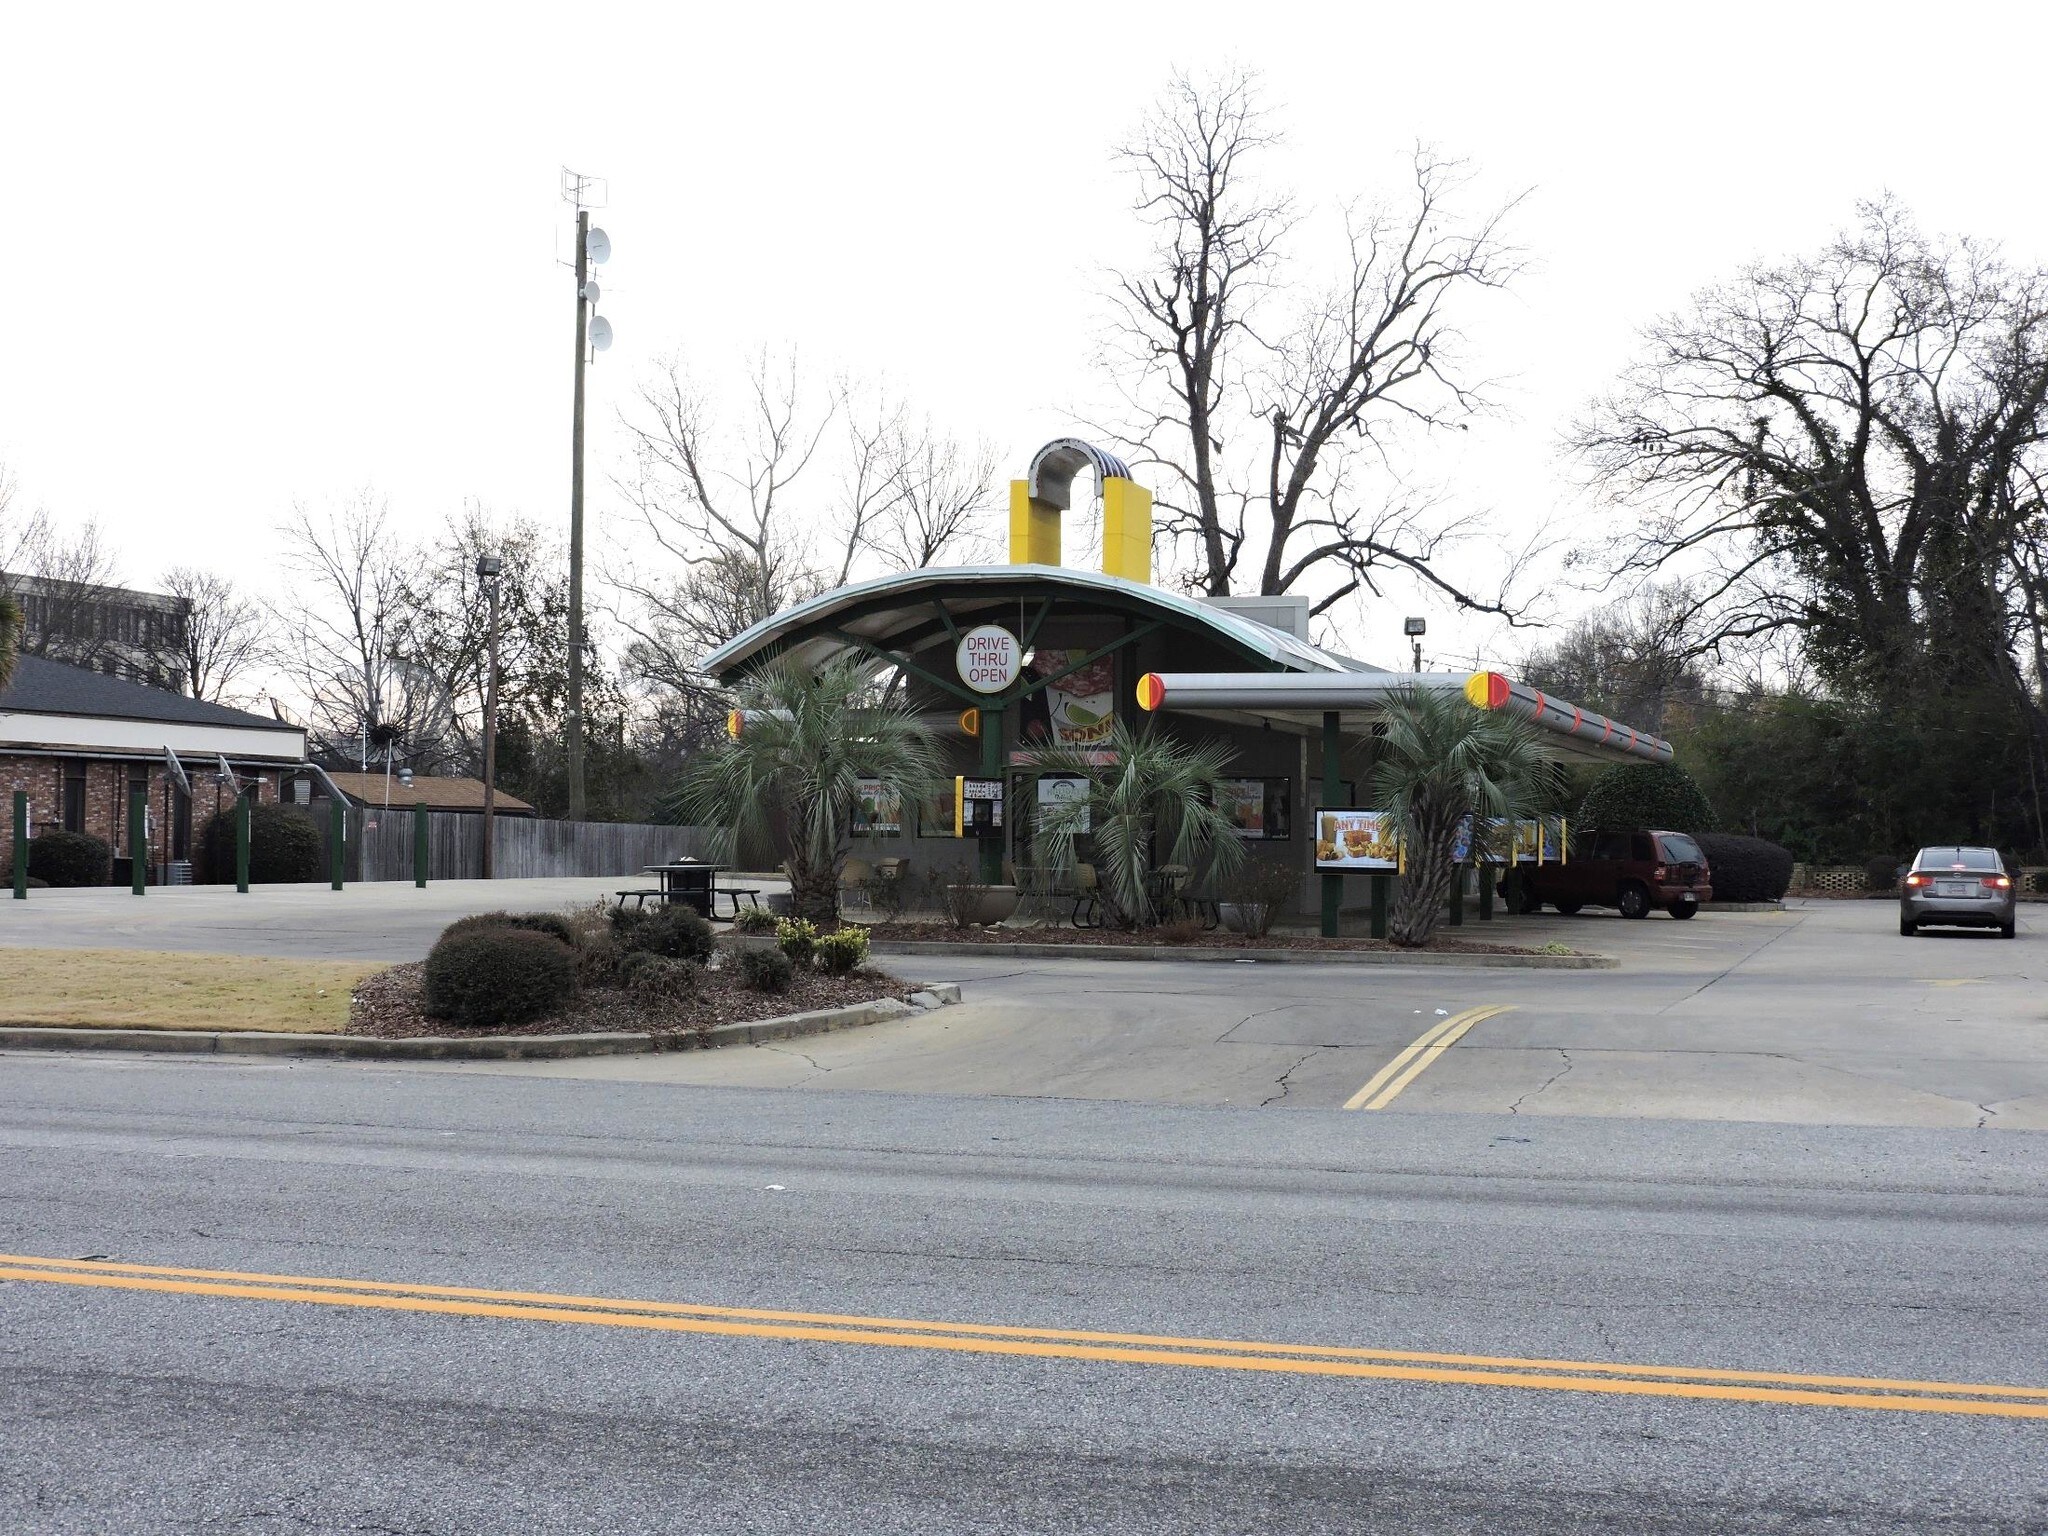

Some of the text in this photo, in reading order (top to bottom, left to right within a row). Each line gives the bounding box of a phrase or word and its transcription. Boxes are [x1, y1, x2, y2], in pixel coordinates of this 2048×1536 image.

[967, 637, 1010, 650] DRIVE
[969, 653, 1008, 666] THRU
[969, 669, 1007, 682] OPEN
[1059, 717, 1114, 741] SONI
[1334, 819, 1356, 831] ANY
